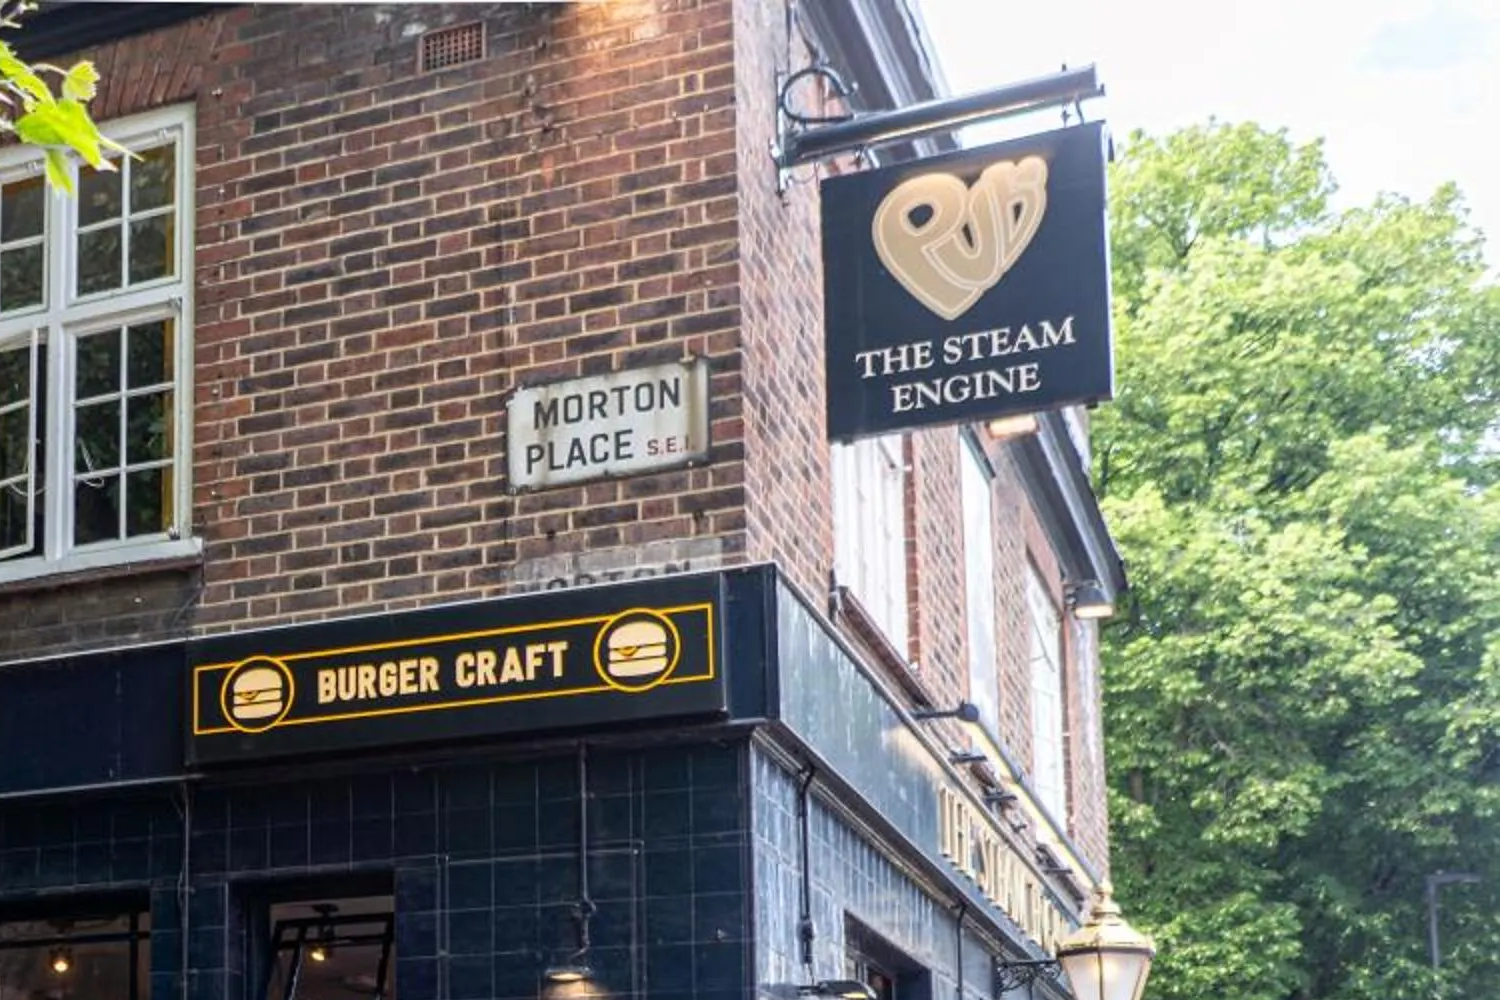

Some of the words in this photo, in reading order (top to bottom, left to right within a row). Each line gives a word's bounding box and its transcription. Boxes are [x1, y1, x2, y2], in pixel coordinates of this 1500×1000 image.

[854, 340, 935, 379] THE
[942, 315, 1077, 365] STEAM
[533, 377, 681, 430] MORTON
[891, 362, 1042, 413] ENGINE
[526, 429, 634, 475] PLACE
[316, 658, 440, 704] BURGER
[454, 640, 569, 688] CRAFT
